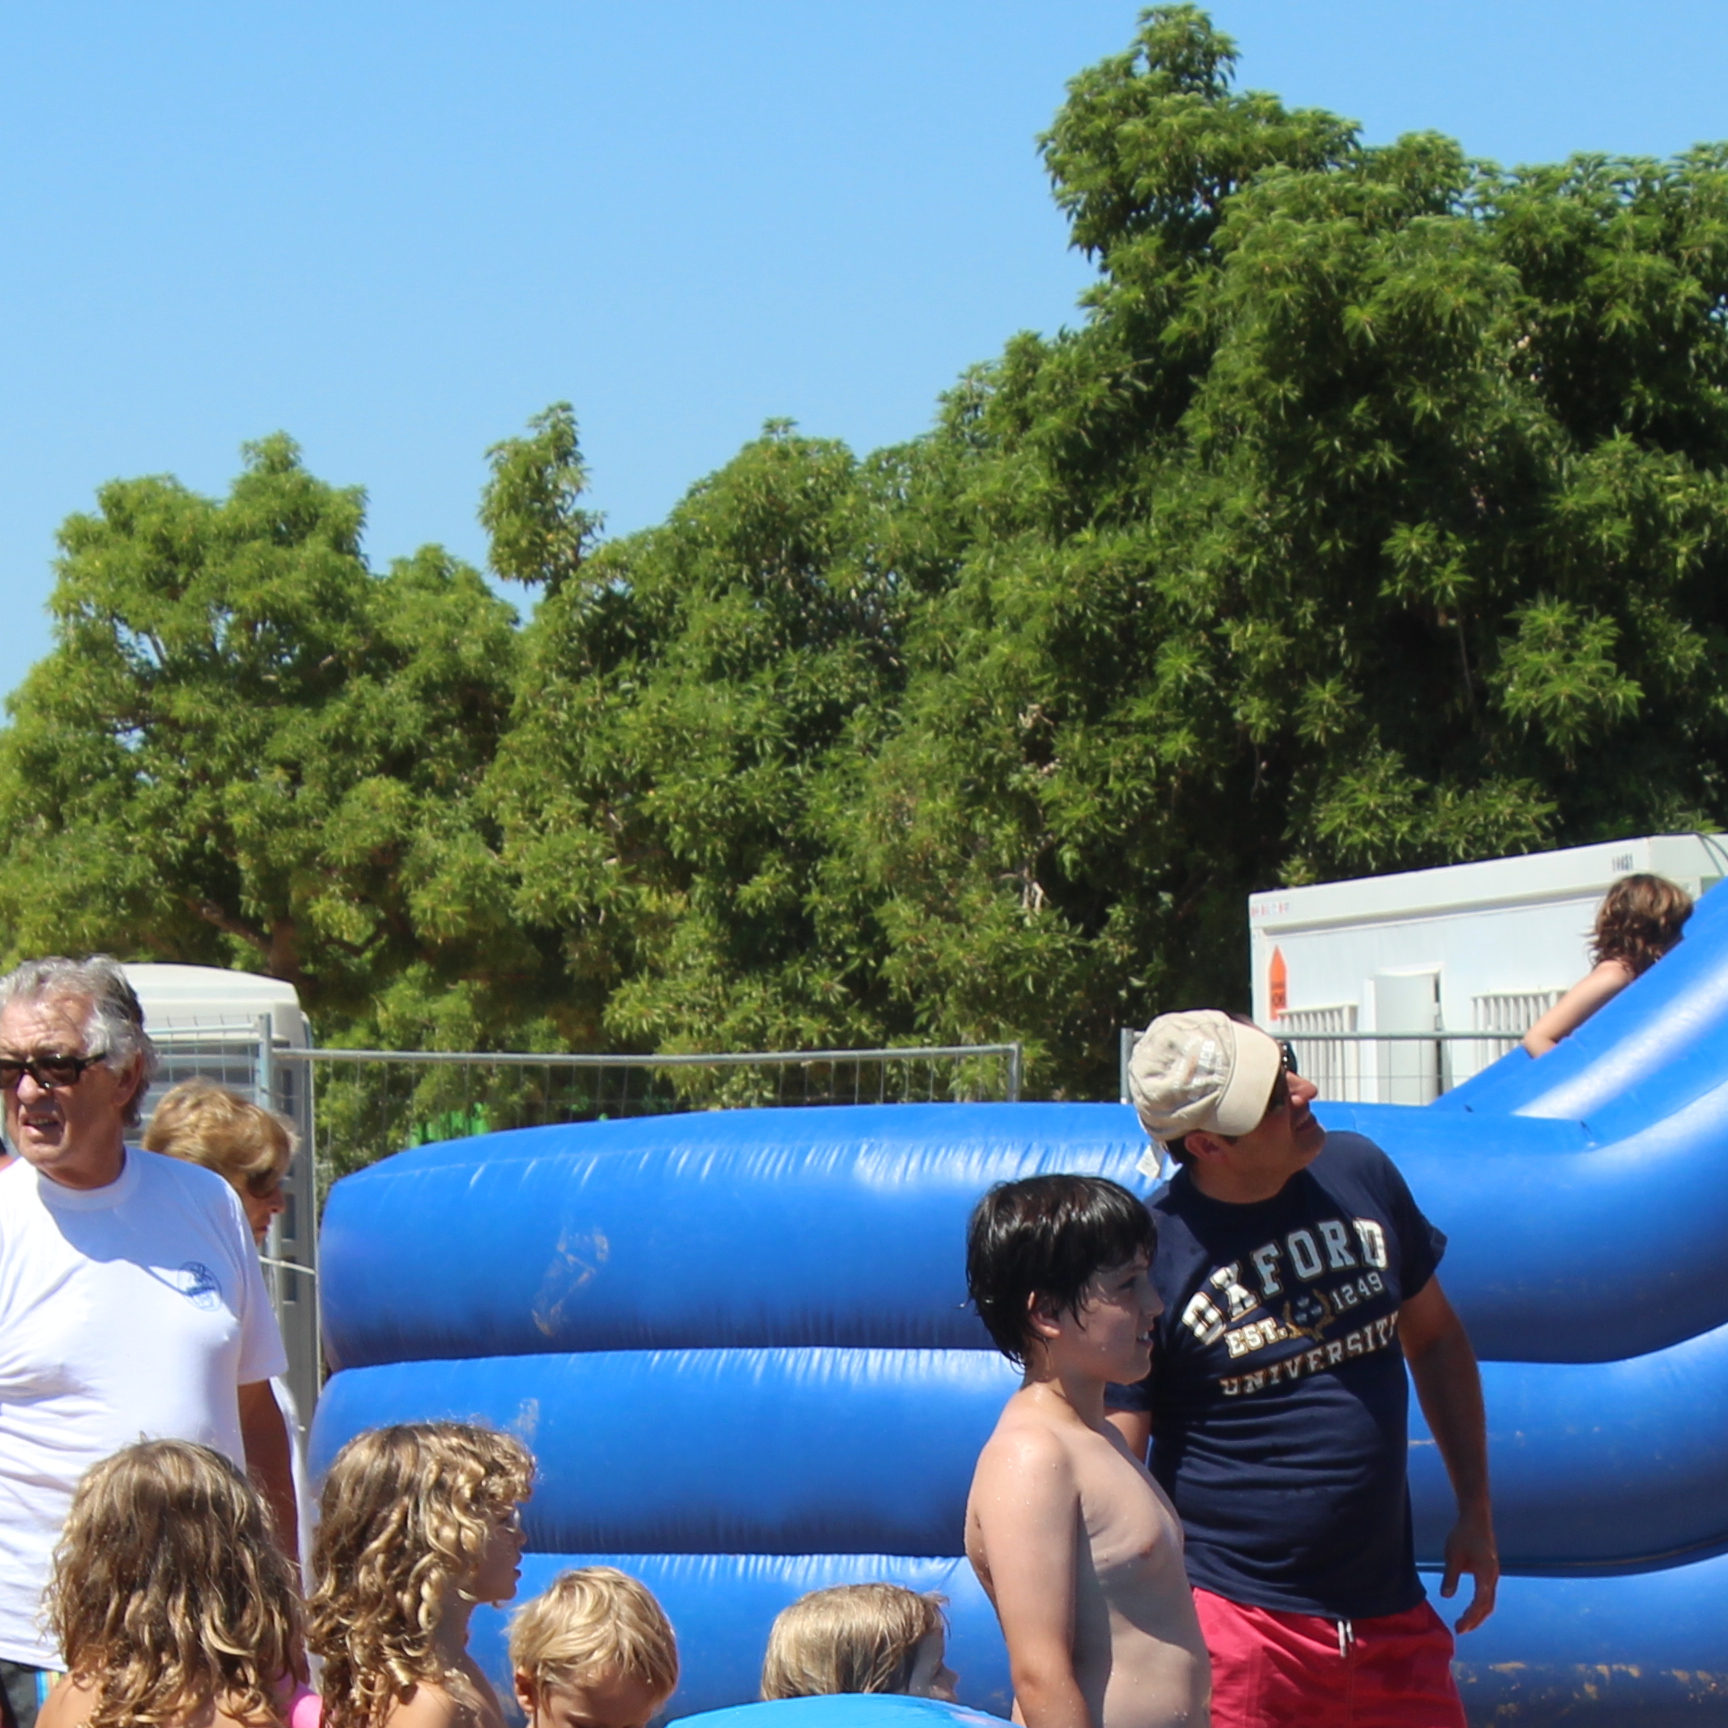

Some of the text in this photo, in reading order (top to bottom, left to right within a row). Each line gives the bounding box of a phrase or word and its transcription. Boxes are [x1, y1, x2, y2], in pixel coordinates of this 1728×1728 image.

[1181, 1216, 1390, 1345] OXFORD
[1223, 1271, 1385, 1359] EST. 1249
